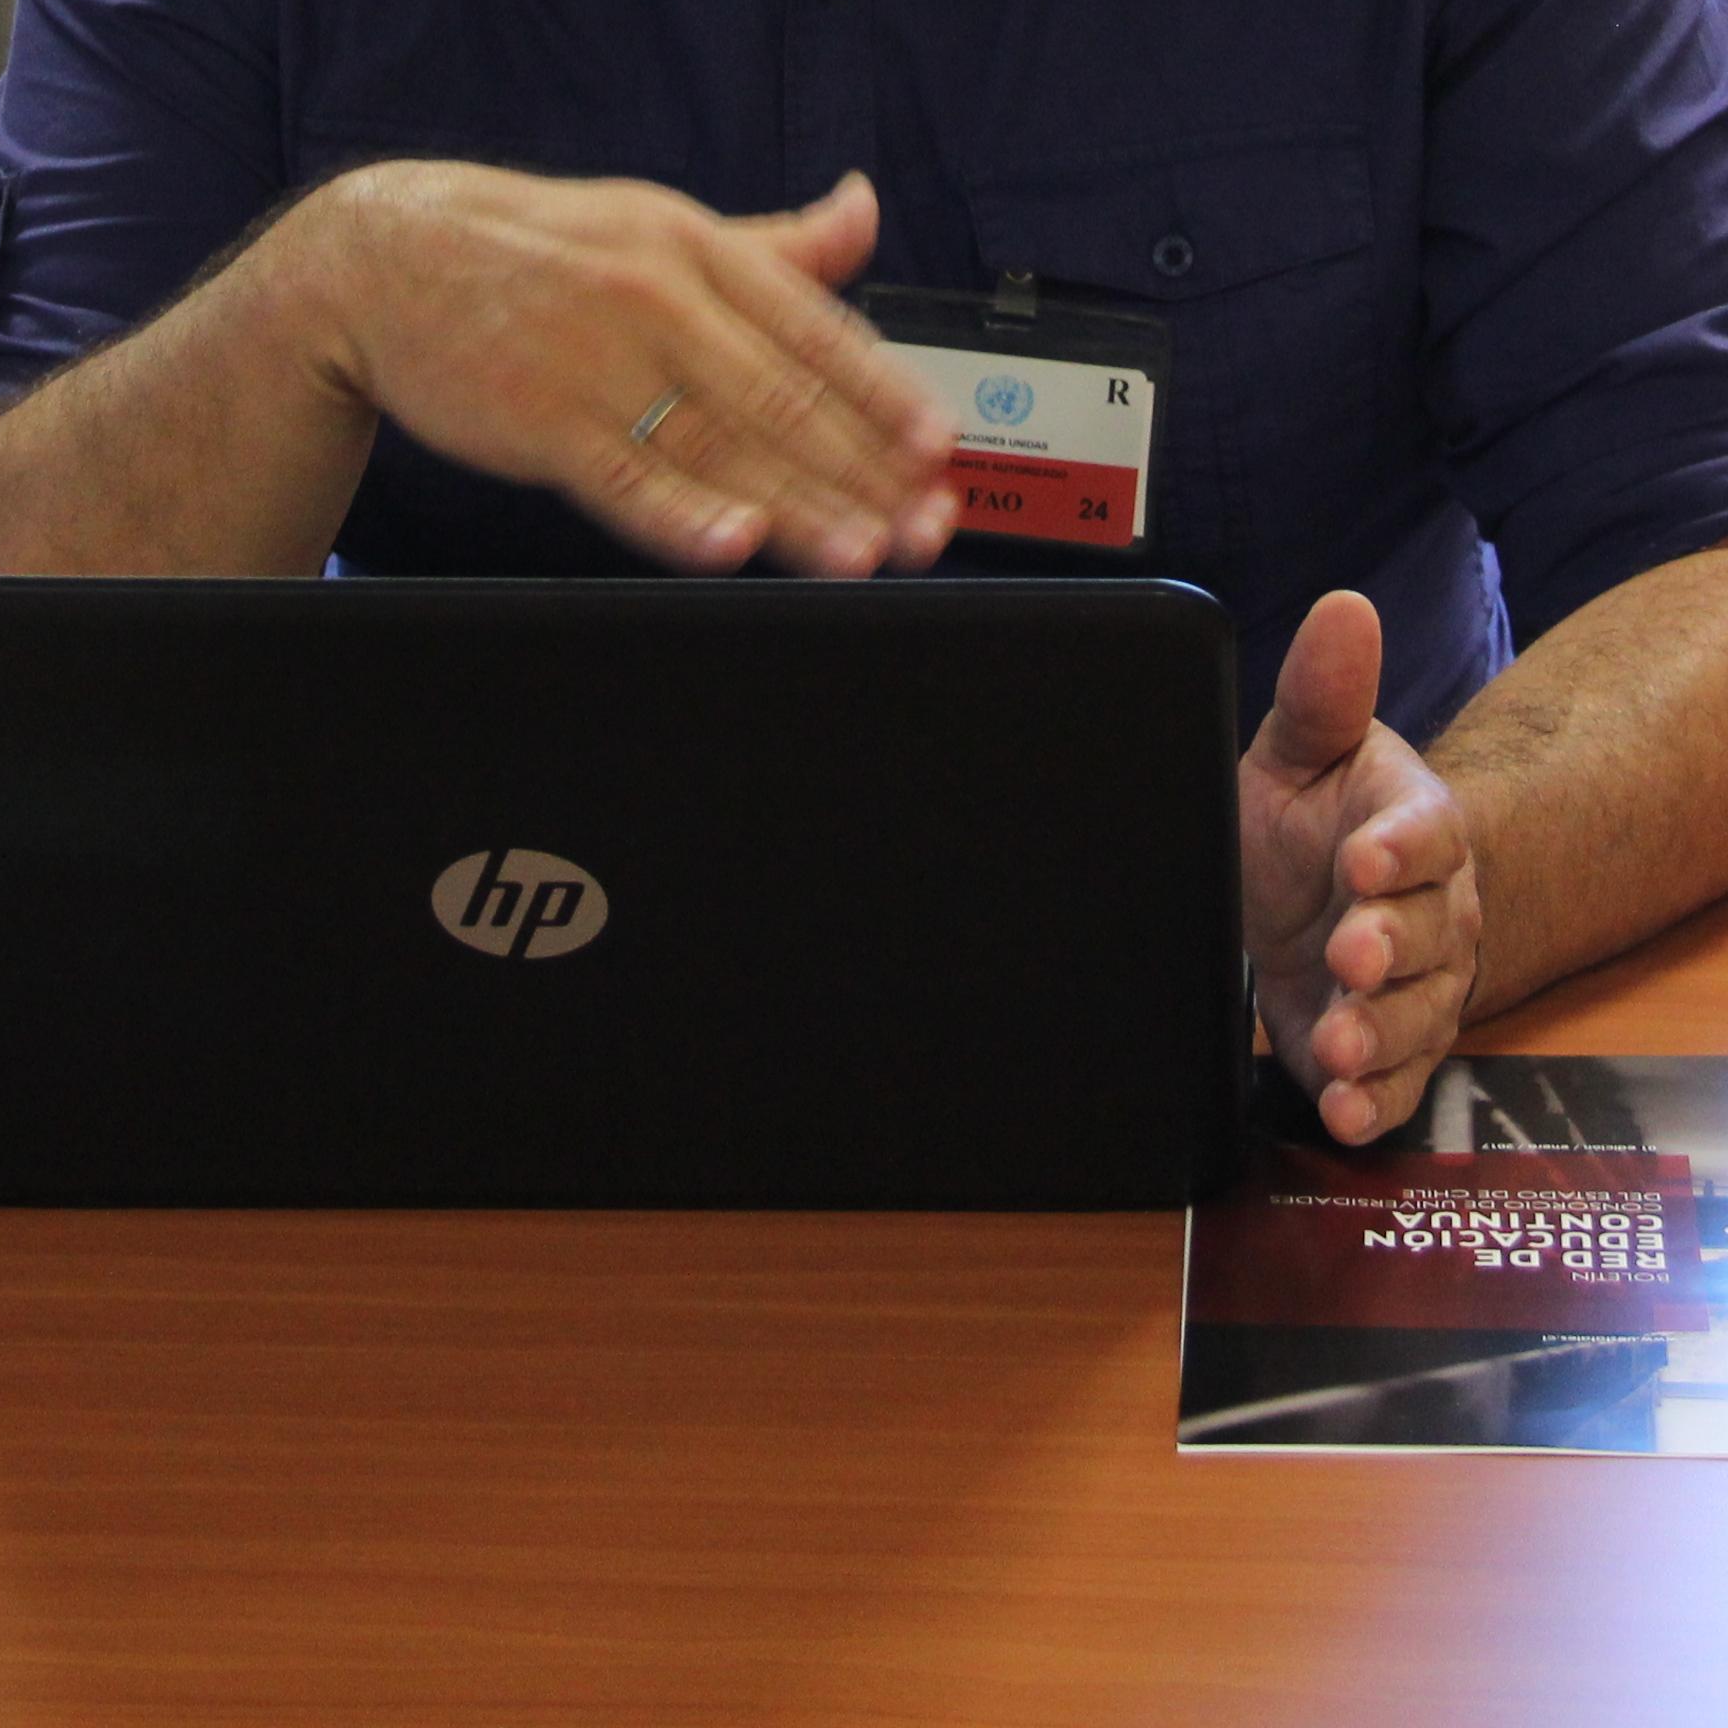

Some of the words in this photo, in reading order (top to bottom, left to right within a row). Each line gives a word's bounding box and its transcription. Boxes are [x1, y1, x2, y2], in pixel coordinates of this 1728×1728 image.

[1106, 377, 1130, 406] R
[1008, 439, 1048, 451] UNIDAS
[966, 486, 1023, 513] FAO
[1078, 497, 1109, 521] 24
[459, 848, 585, 960] hp
[1481, 1142, 1513, 1152] 2017
[1528, 1143, 1571, 1152] enero
[1583, 1143, 1637, 1153] edición
[1401, 1187, 1471, 1200] CHILE
[1477, 1188, 1510, 1200] DE
[1516, 1190, 1611, 1202] ESTADO
[1617, 1191, 1662, 1202] DEL
[1269, 1195, 1457, 1210] UNIVERSIDADES
[1464, 1199, 1496, 1210] DE
[1503, 1200, 1663, 1212] CONSORCIO
[1392, 1211, 1665, 1231] CONTINUA
[1363, 1229, 1665, 1251] EDUCACIÓN
[1474, 1248, 1541, 1268] DE
[1562, 1250, 1667, 1270] RED
[1571, 1271, 1671, 1284] BOLETÍN
